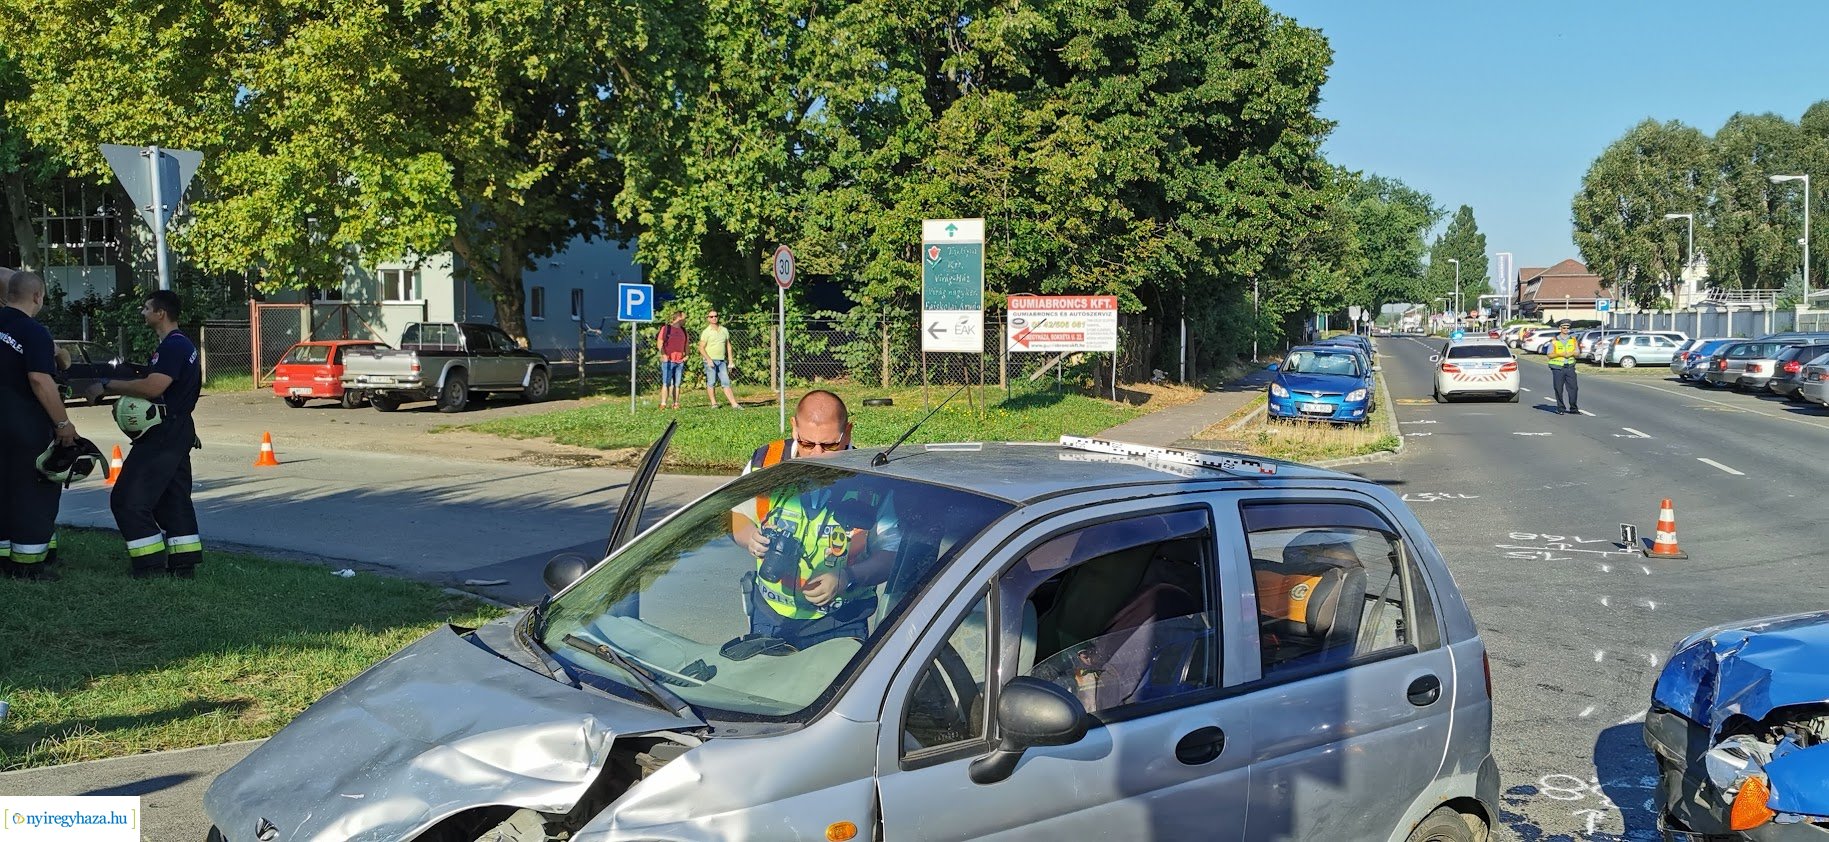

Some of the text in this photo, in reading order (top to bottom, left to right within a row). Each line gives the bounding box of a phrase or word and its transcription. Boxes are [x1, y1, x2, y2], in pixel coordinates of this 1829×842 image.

[779, 259, 790, 275] 30
[626, 289, 645, 316] P
[1011, 298, 1112, 309] GUMIABRONCS KFT.
[1598, 300, 1608, 311] P
[1625, 526, 1632, 542] 1
